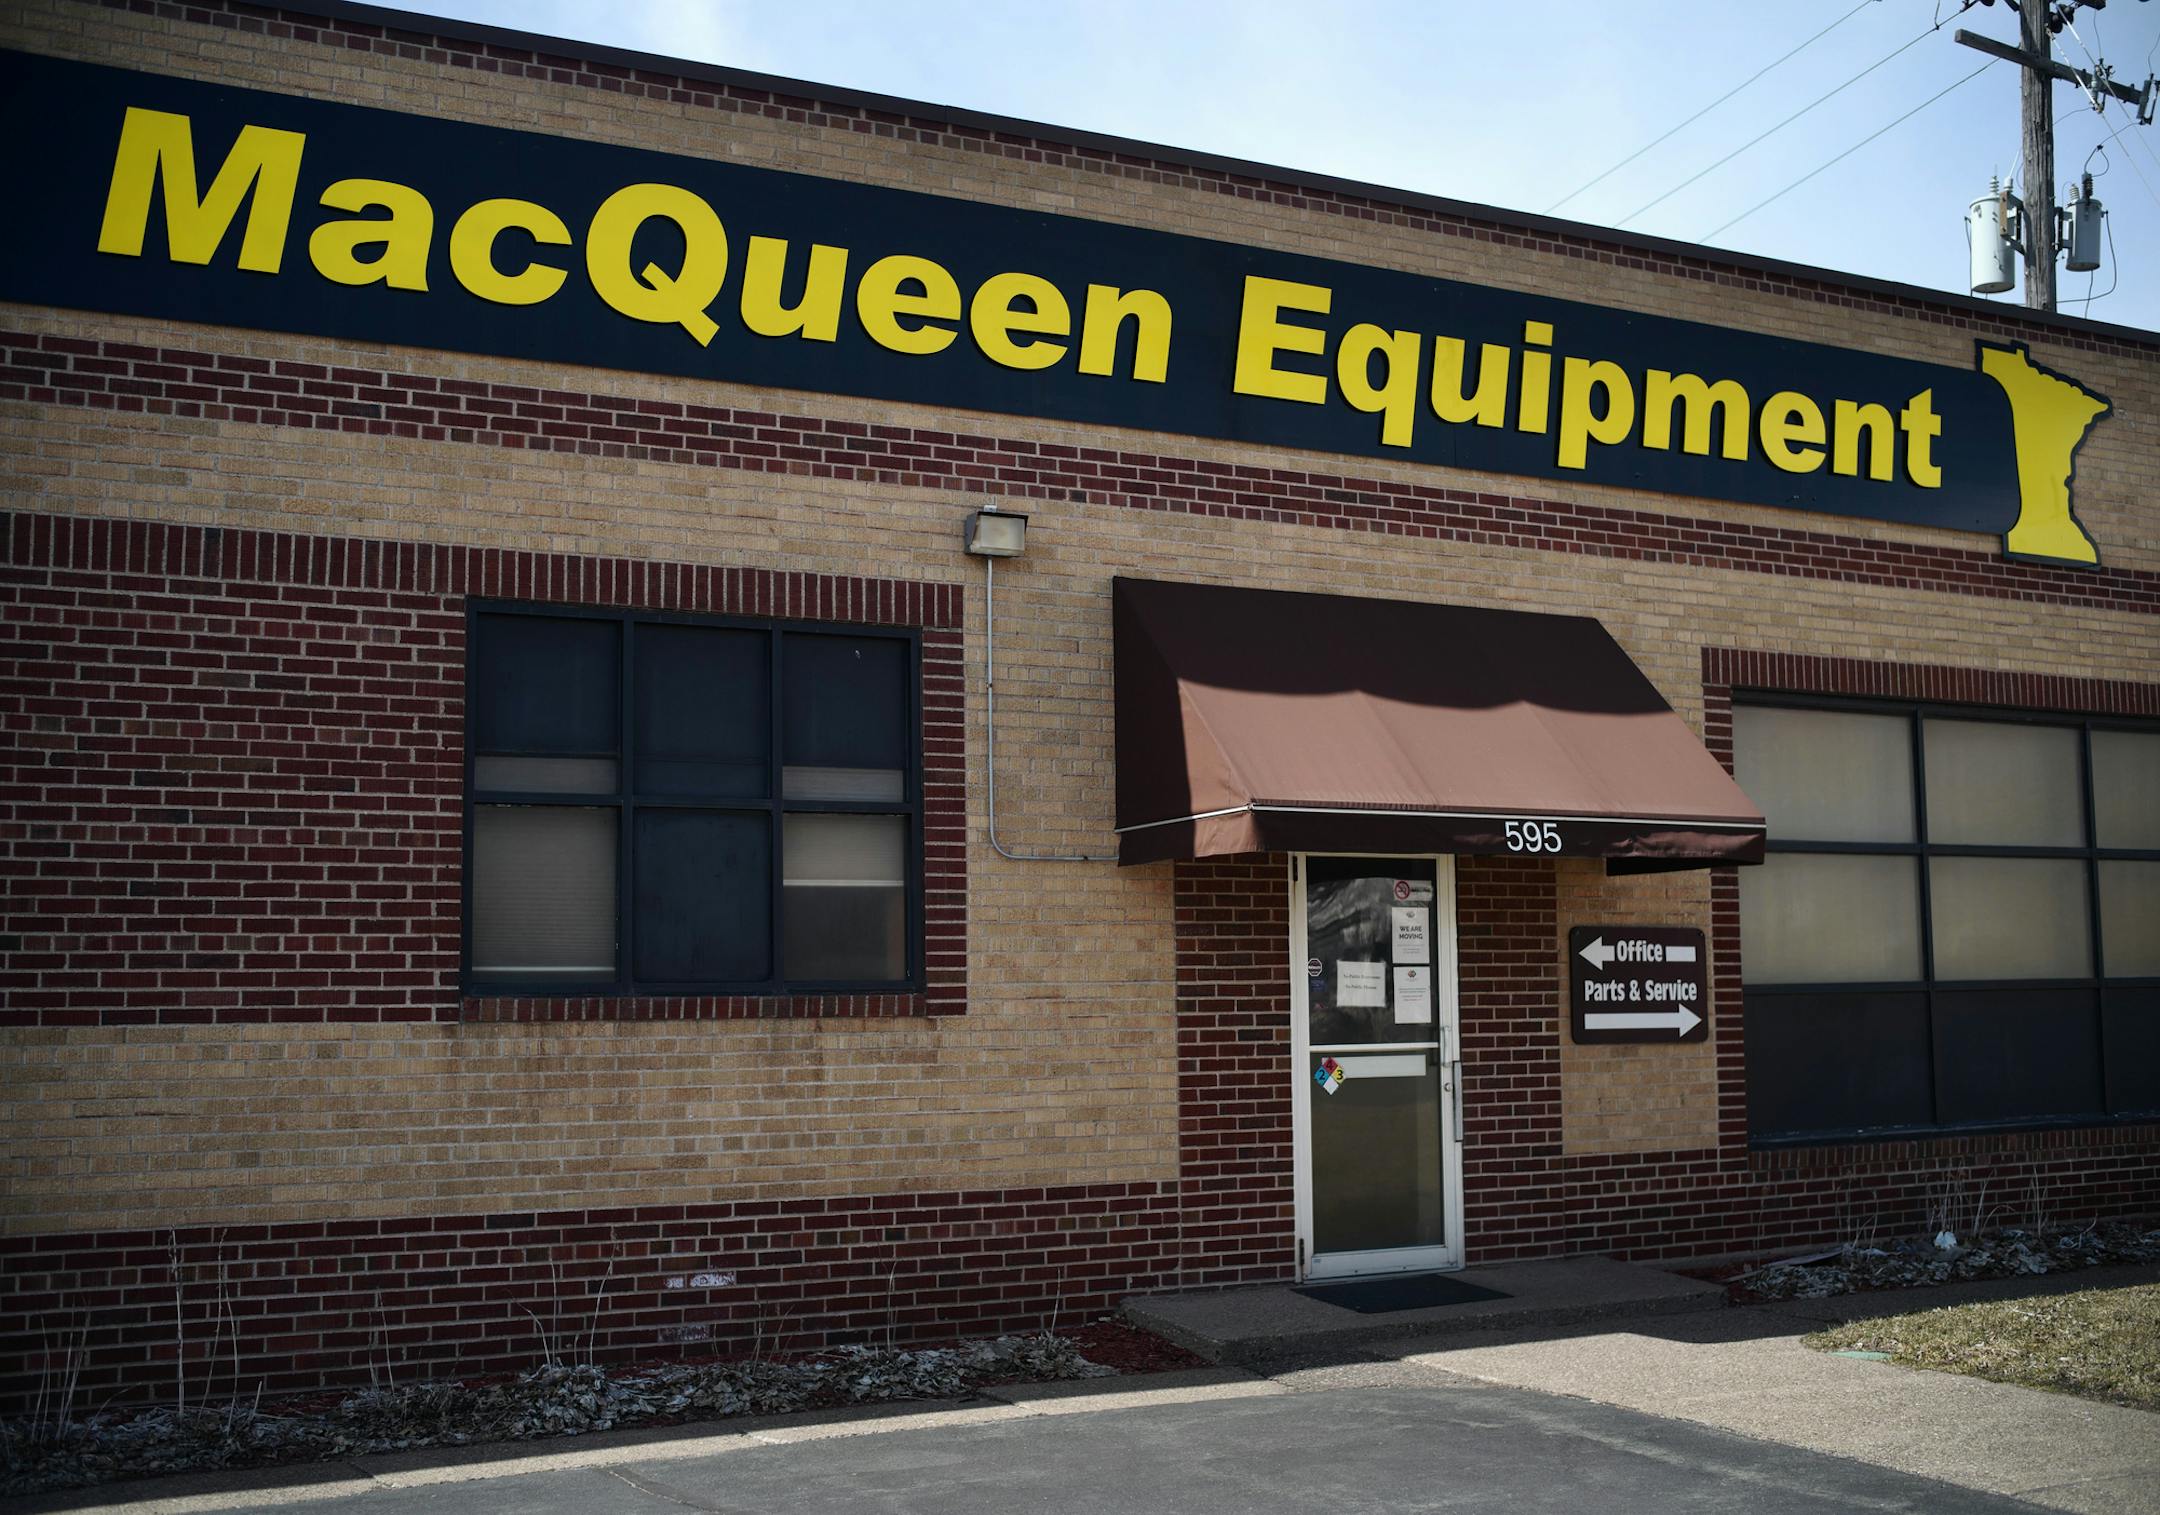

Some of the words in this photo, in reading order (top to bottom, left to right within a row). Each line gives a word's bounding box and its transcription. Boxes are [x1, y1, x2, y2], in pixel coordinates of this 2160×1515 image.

[98, 106, 1172, 383] MacQueen
[1234, 277, 1942, 487] Equipment
[1504, 820, 1563, 853] 595
[1616, 939, 1663, 962] Office
[1584, 979, 1626, 1002] Parts
[1628, 979, 1641, 1002] &
[1645, 979, 1698, 1002] Service
[1318, 1069, 1326, 1081] 2
[1336, 1069, 1344, 1081] 3
